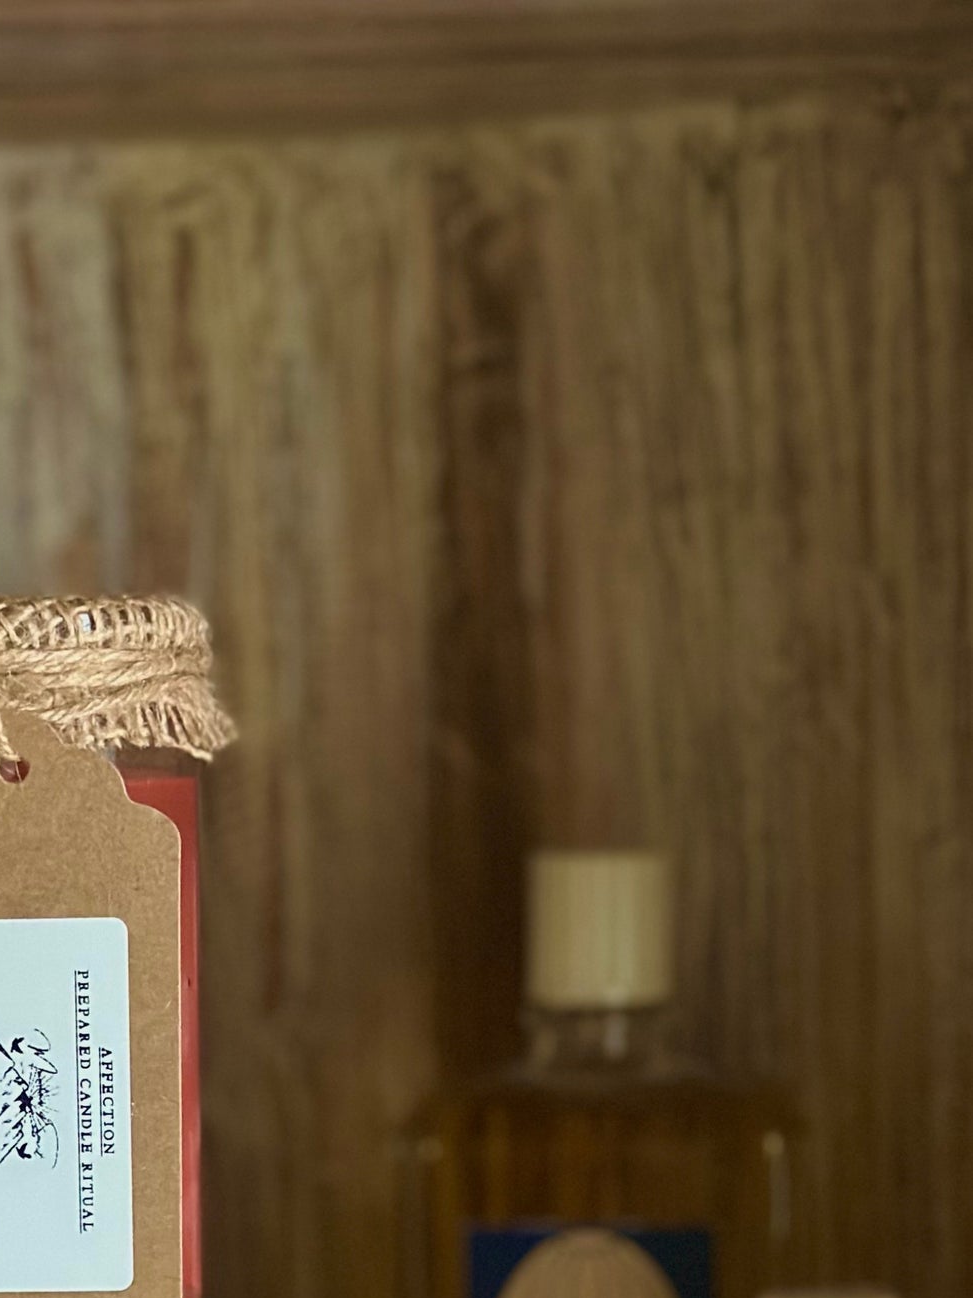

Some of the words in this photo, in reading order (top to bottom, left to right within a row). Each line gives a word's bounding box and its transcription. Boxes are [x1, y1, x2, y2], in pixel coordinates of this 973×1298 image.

[75, 969, 91, 1072] PREPARED
[78, 1079, 94, 1154] CANDLE
[99, 1046, 116, 1157] AFFECTION
[80, 1161, 95, 1234] RITUAL
